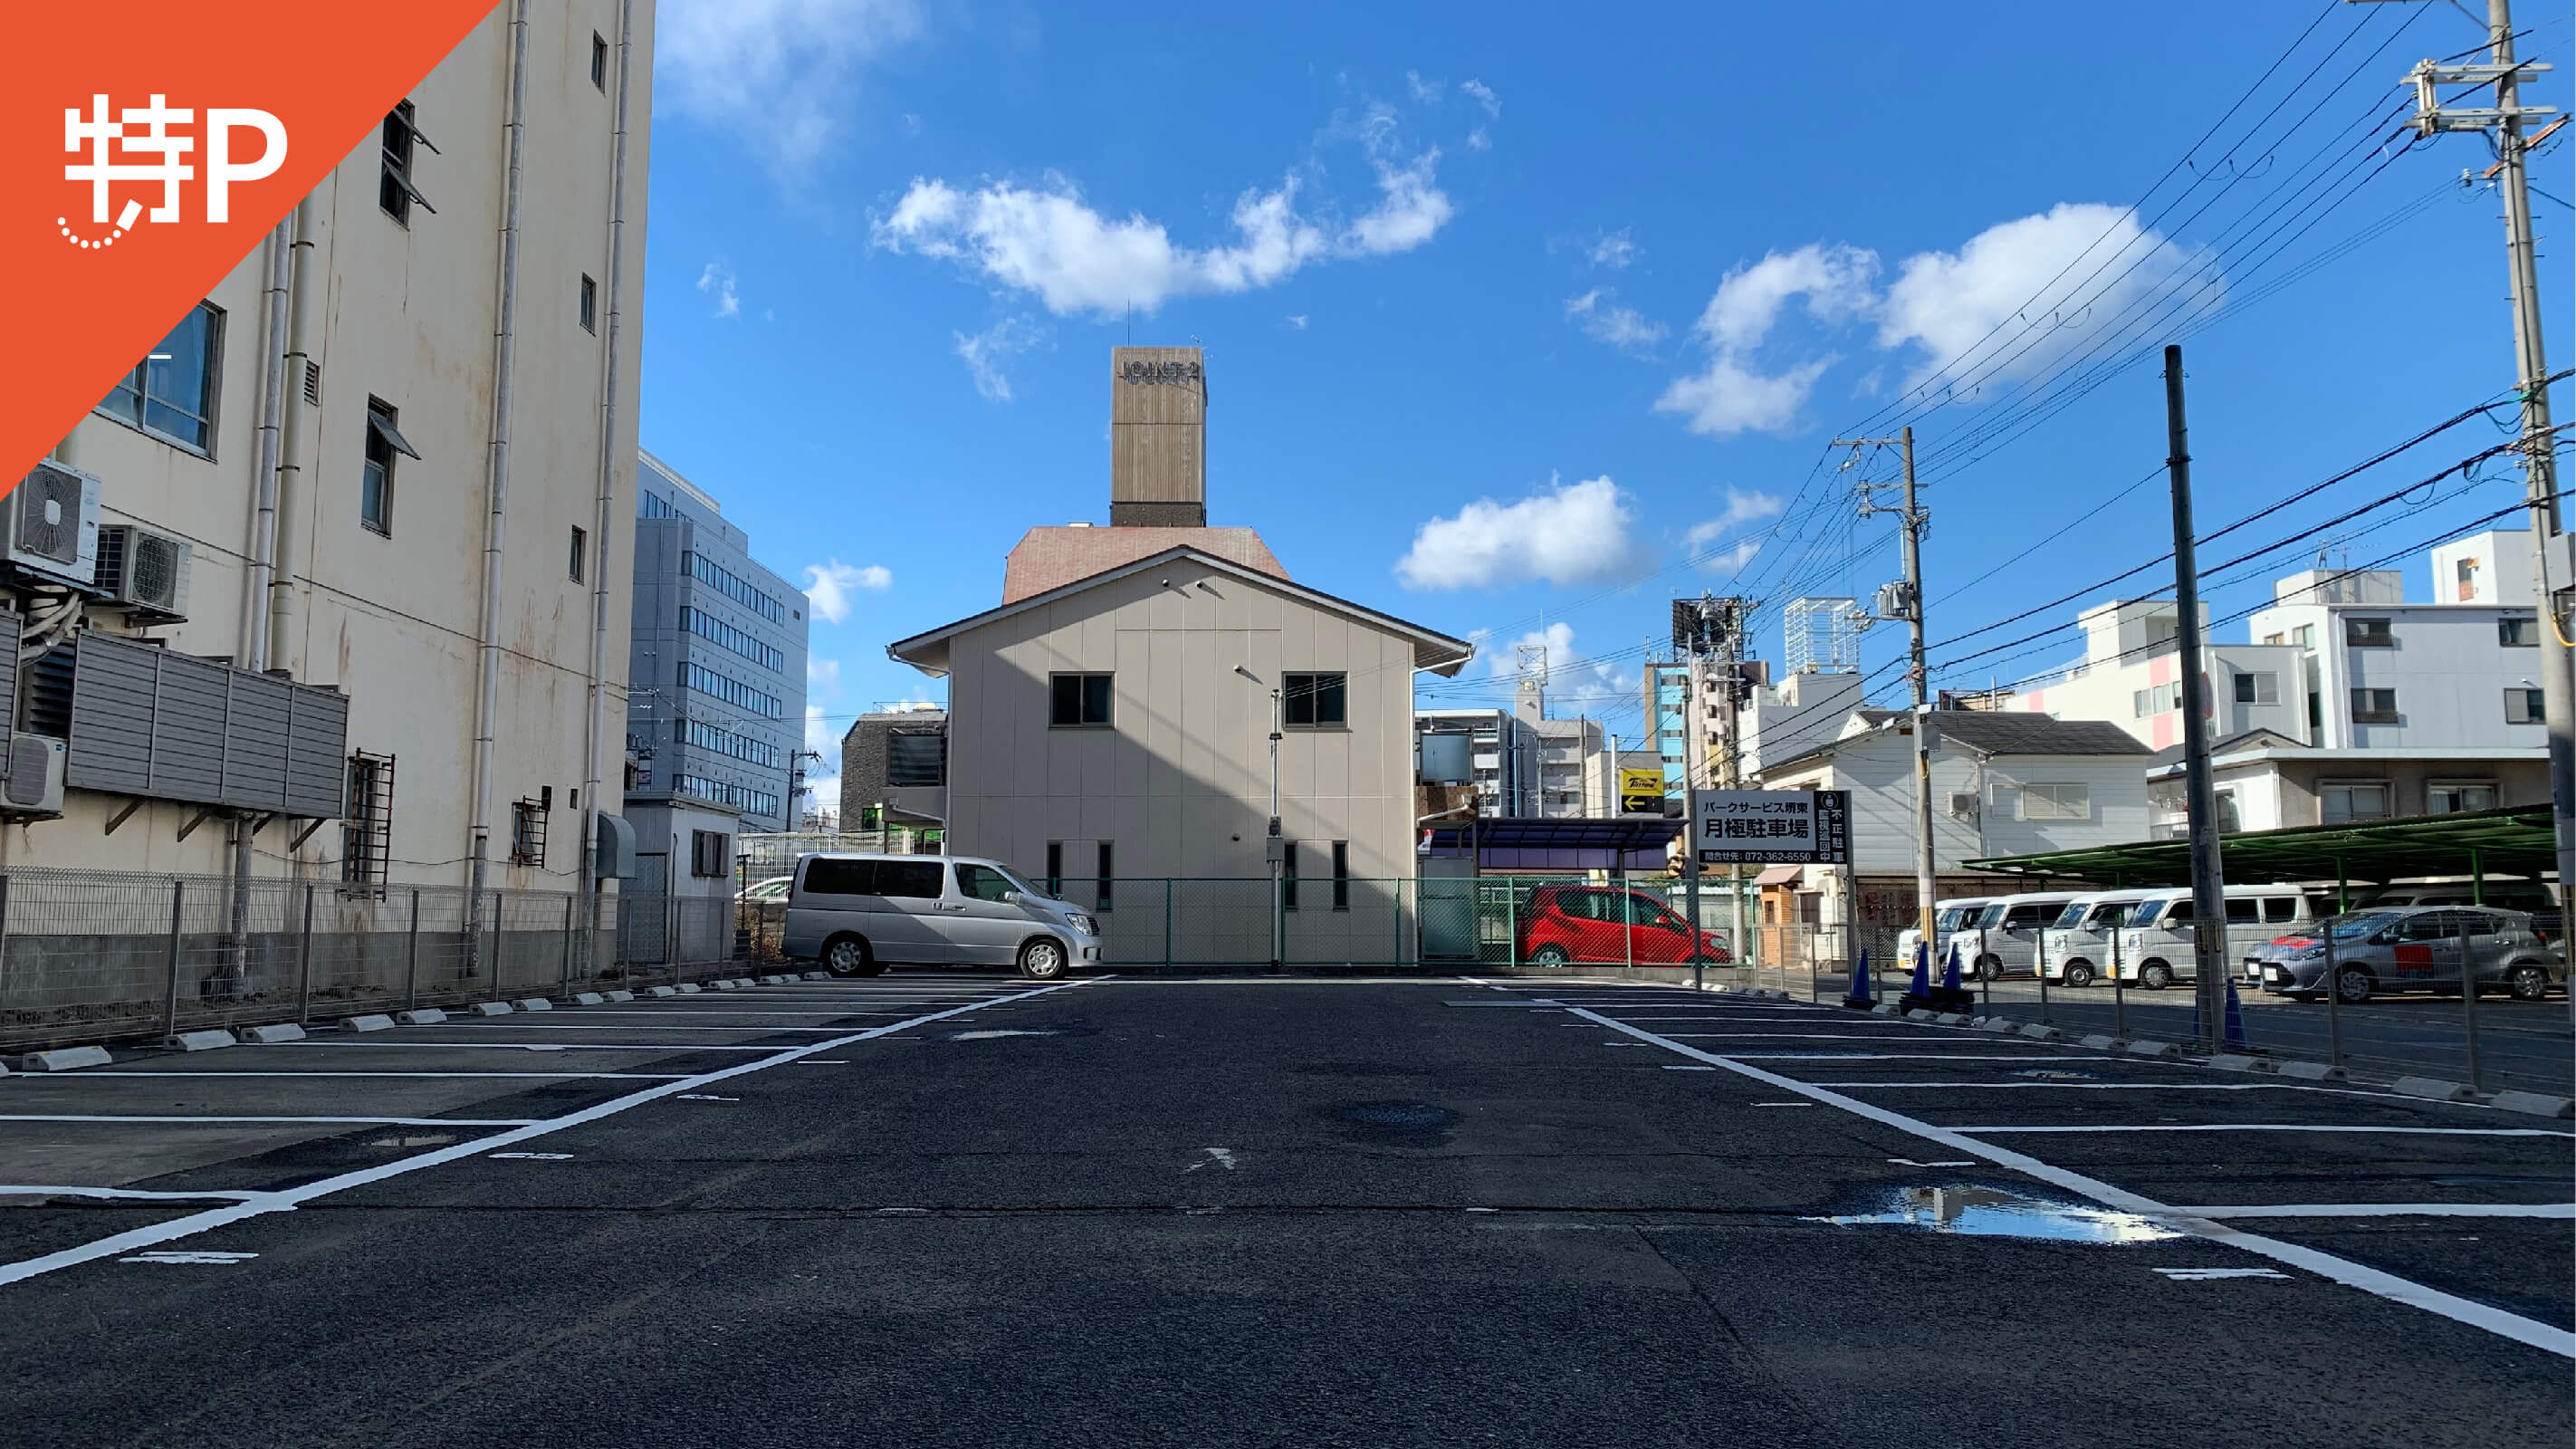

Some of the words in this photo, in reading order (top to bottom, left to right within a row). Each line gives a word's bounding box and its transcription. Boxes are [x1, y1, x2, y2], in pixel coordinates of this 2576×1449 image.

[1704, 801, 1808, 813] パークサービス堺東
[1705, 818, 1809, 839] 月極駐車場
